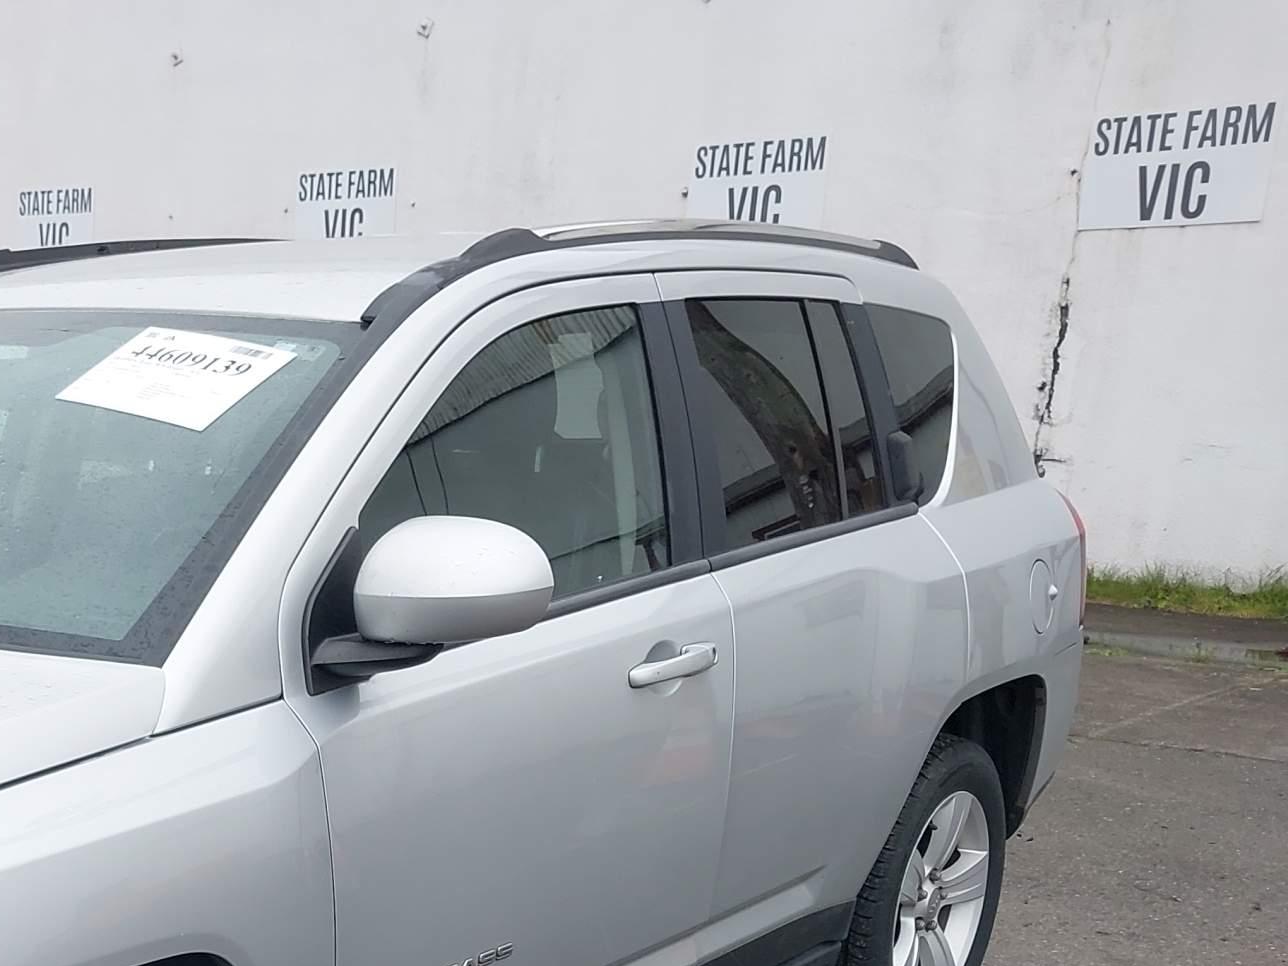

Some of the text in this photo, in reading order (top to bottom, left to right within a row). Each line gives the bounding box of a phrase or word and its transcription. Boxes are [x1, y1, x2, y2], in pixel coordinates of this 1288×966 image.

[1094, 101, 1277, 156] STATE FARM
[695, 135, 827, 179] STATE FARM
[19, 187, 92, 216] STATE FARM
[298, 167, 394, 202] STATE FARM
[1137, 160, 1211, 222] VIC
[728, 184, 782, 225] VIC
[39, 221, 69, 247] VIC
[324, 207, 364, 239] VIC
[131, 344, 253, 376] 44609139
